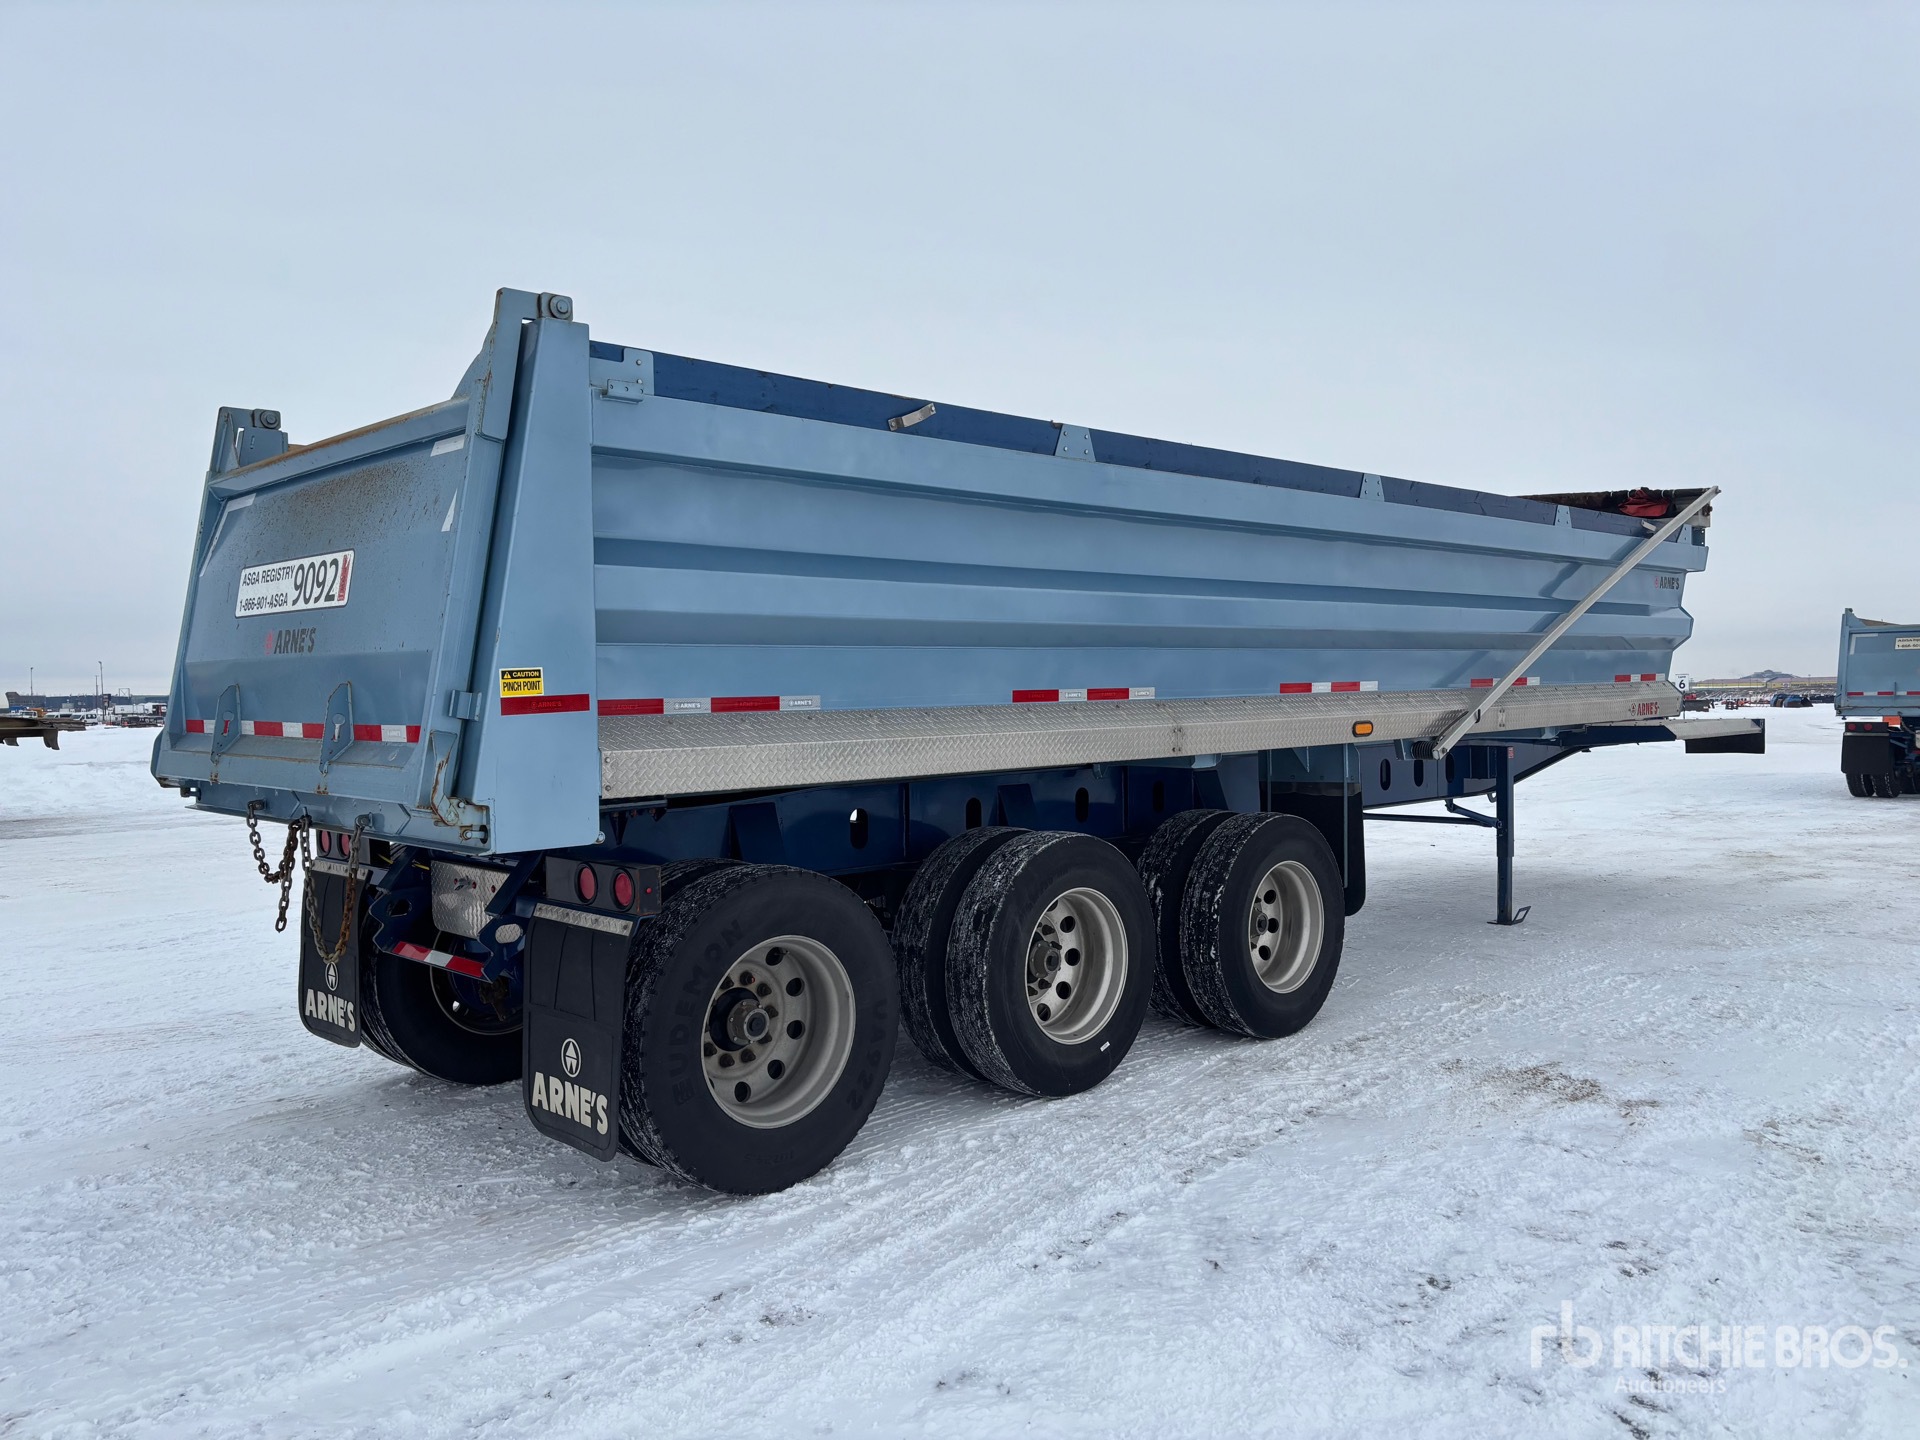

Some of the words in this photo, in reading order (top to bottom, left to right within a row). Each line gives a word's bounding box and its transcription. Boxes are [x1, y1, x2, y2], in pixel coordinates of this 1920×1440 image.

[242, 572, 260, 586] ASGA
[261, 565, 295, 583] REGISTRY
[292, 558, 339, 606] 9092
[240, 593, 288, 611] 1-866-901-ASGA
[274, 627, 316, 654] ARNE'S
[503, 681, 522, 691] PINCH
[523, 681, 541, 690] POINT
[1678, 679, 1686, 689] 6
[305, 988, 356, 1032] ARNE'S
[532, 1071, 608, 1135] ARNE'S
